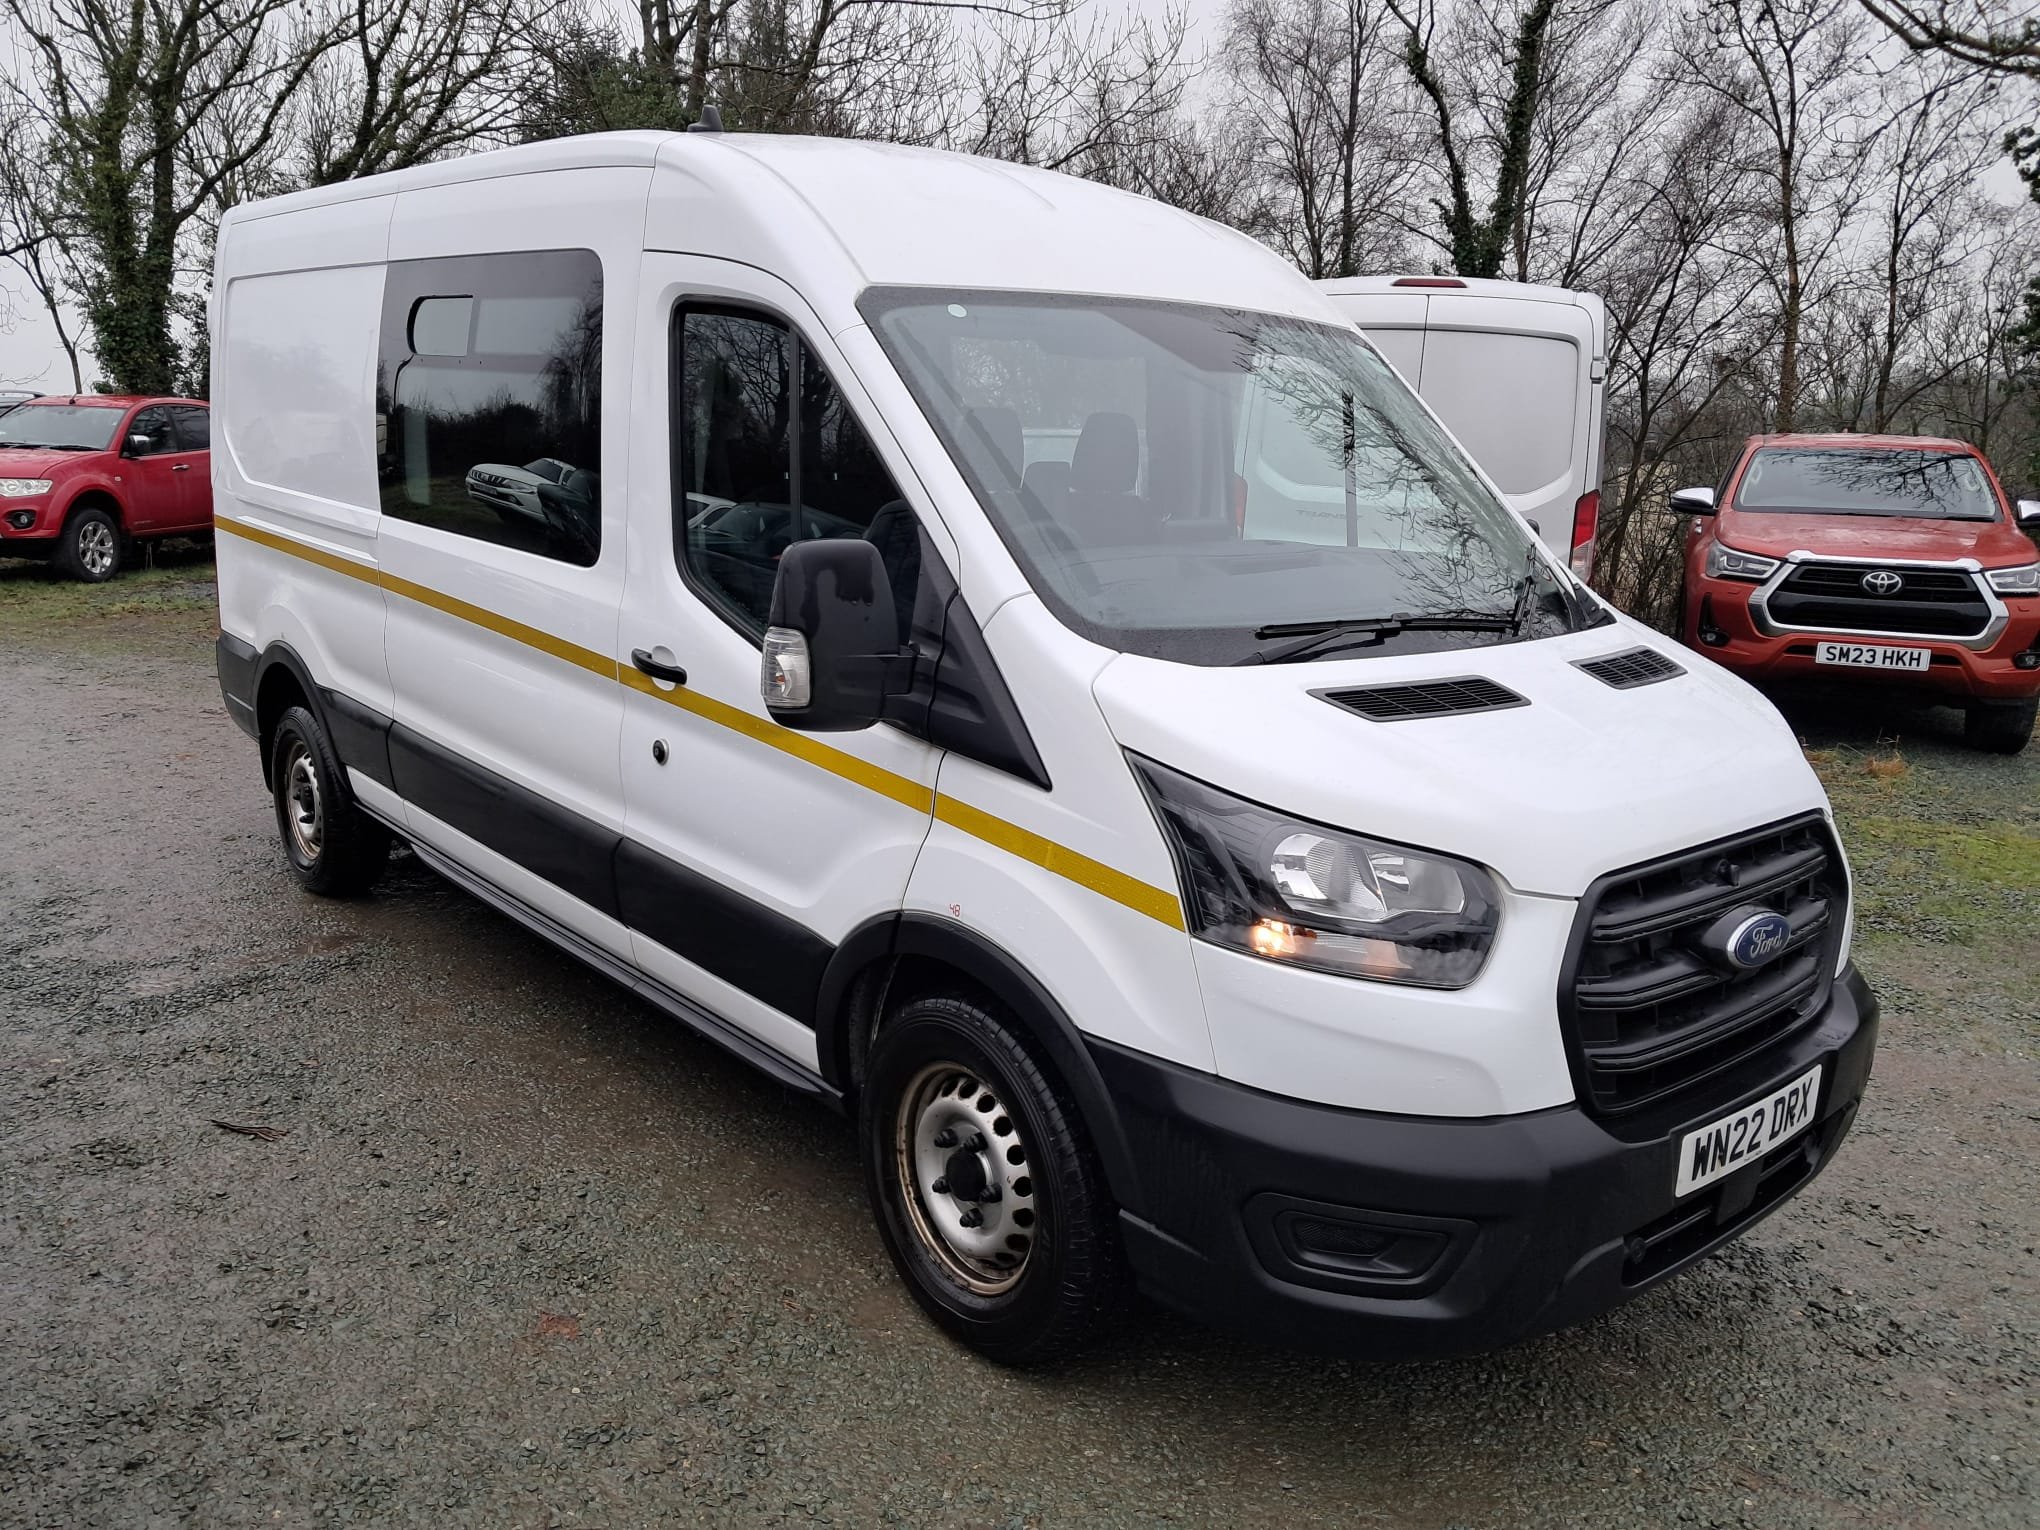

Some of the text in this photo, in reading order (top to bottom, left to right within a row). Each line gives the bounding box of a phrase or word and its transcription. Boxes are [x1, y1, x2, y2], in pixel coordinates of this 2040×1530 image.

[1825, 645, 1922, 668] SM23 HKH
[1750, 924, 1783, 959] Ford
[1691, 1076, 1814, 1182] WN22 DRX
